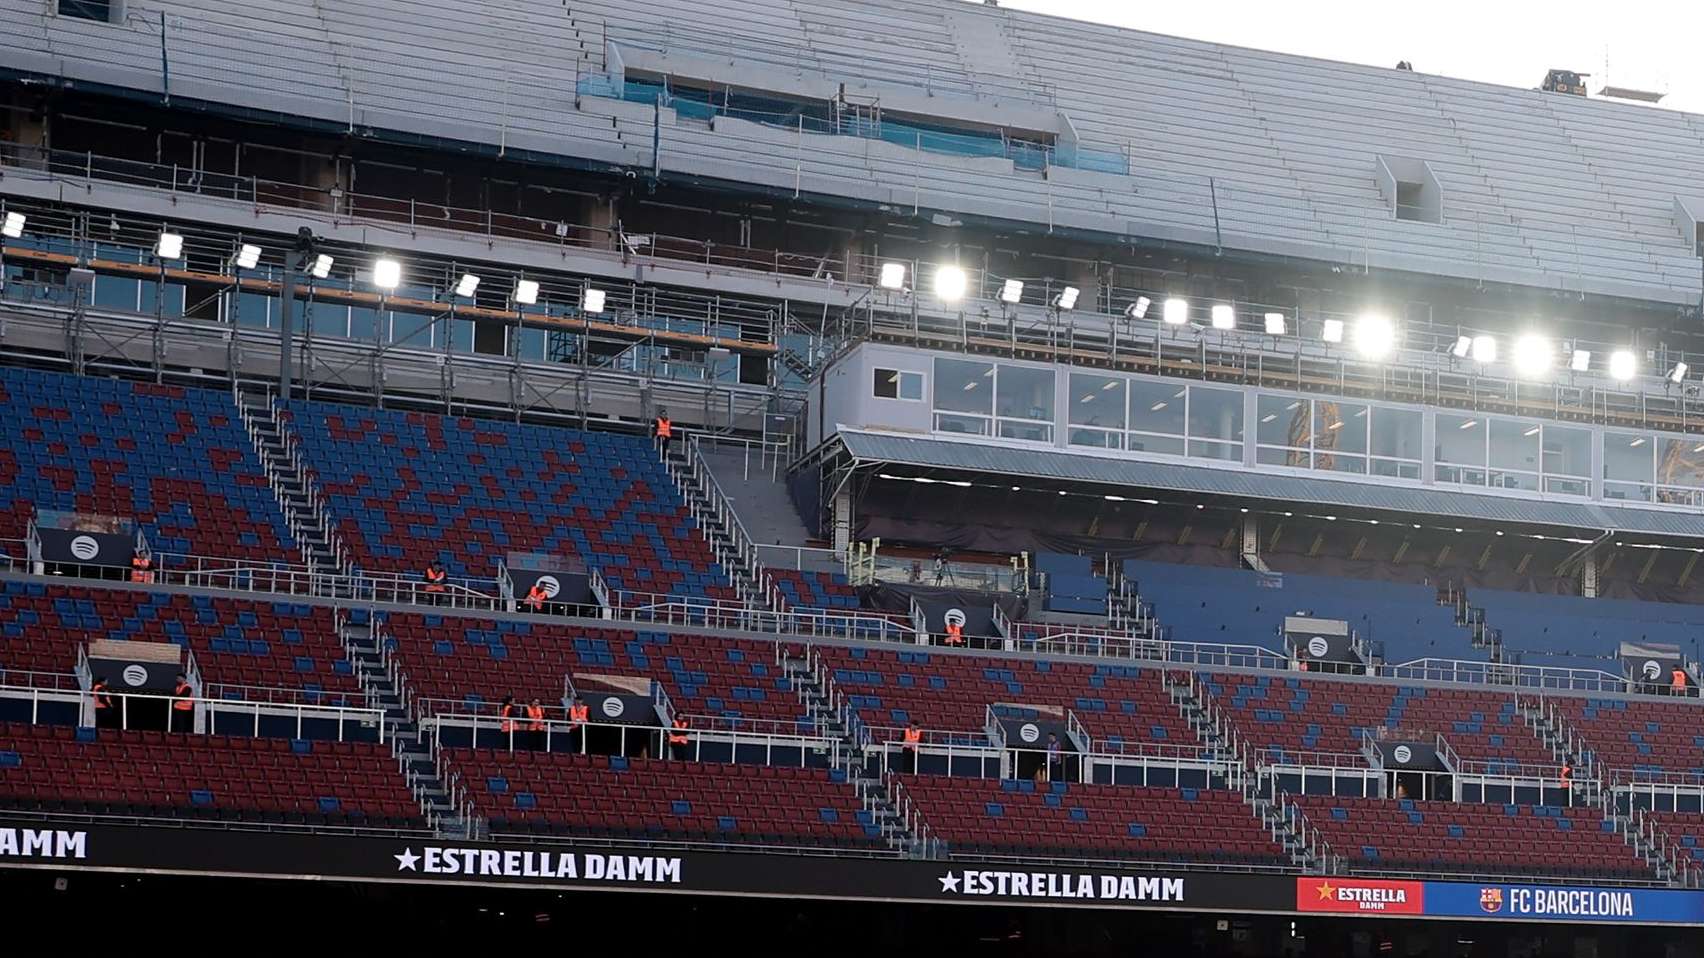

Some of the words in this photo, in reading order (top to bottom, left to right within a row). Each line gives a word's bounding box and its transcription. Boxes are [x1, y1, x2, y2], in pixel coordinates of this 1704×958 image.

[0, 828, 87, 858] AMM
[423, 847, 578, 878] ESTRELLA
[584, 854, 682, 883] DAMM
[963, 870, 1095, 898] ESTRELLA
[1100, 875, 1184, 901] DAMM
[1338, 887, 1406, 902] ESTRELLA
[1510, 888, 1531, 913] FC
[1534, 889, 1634, 917] BARCELONA
